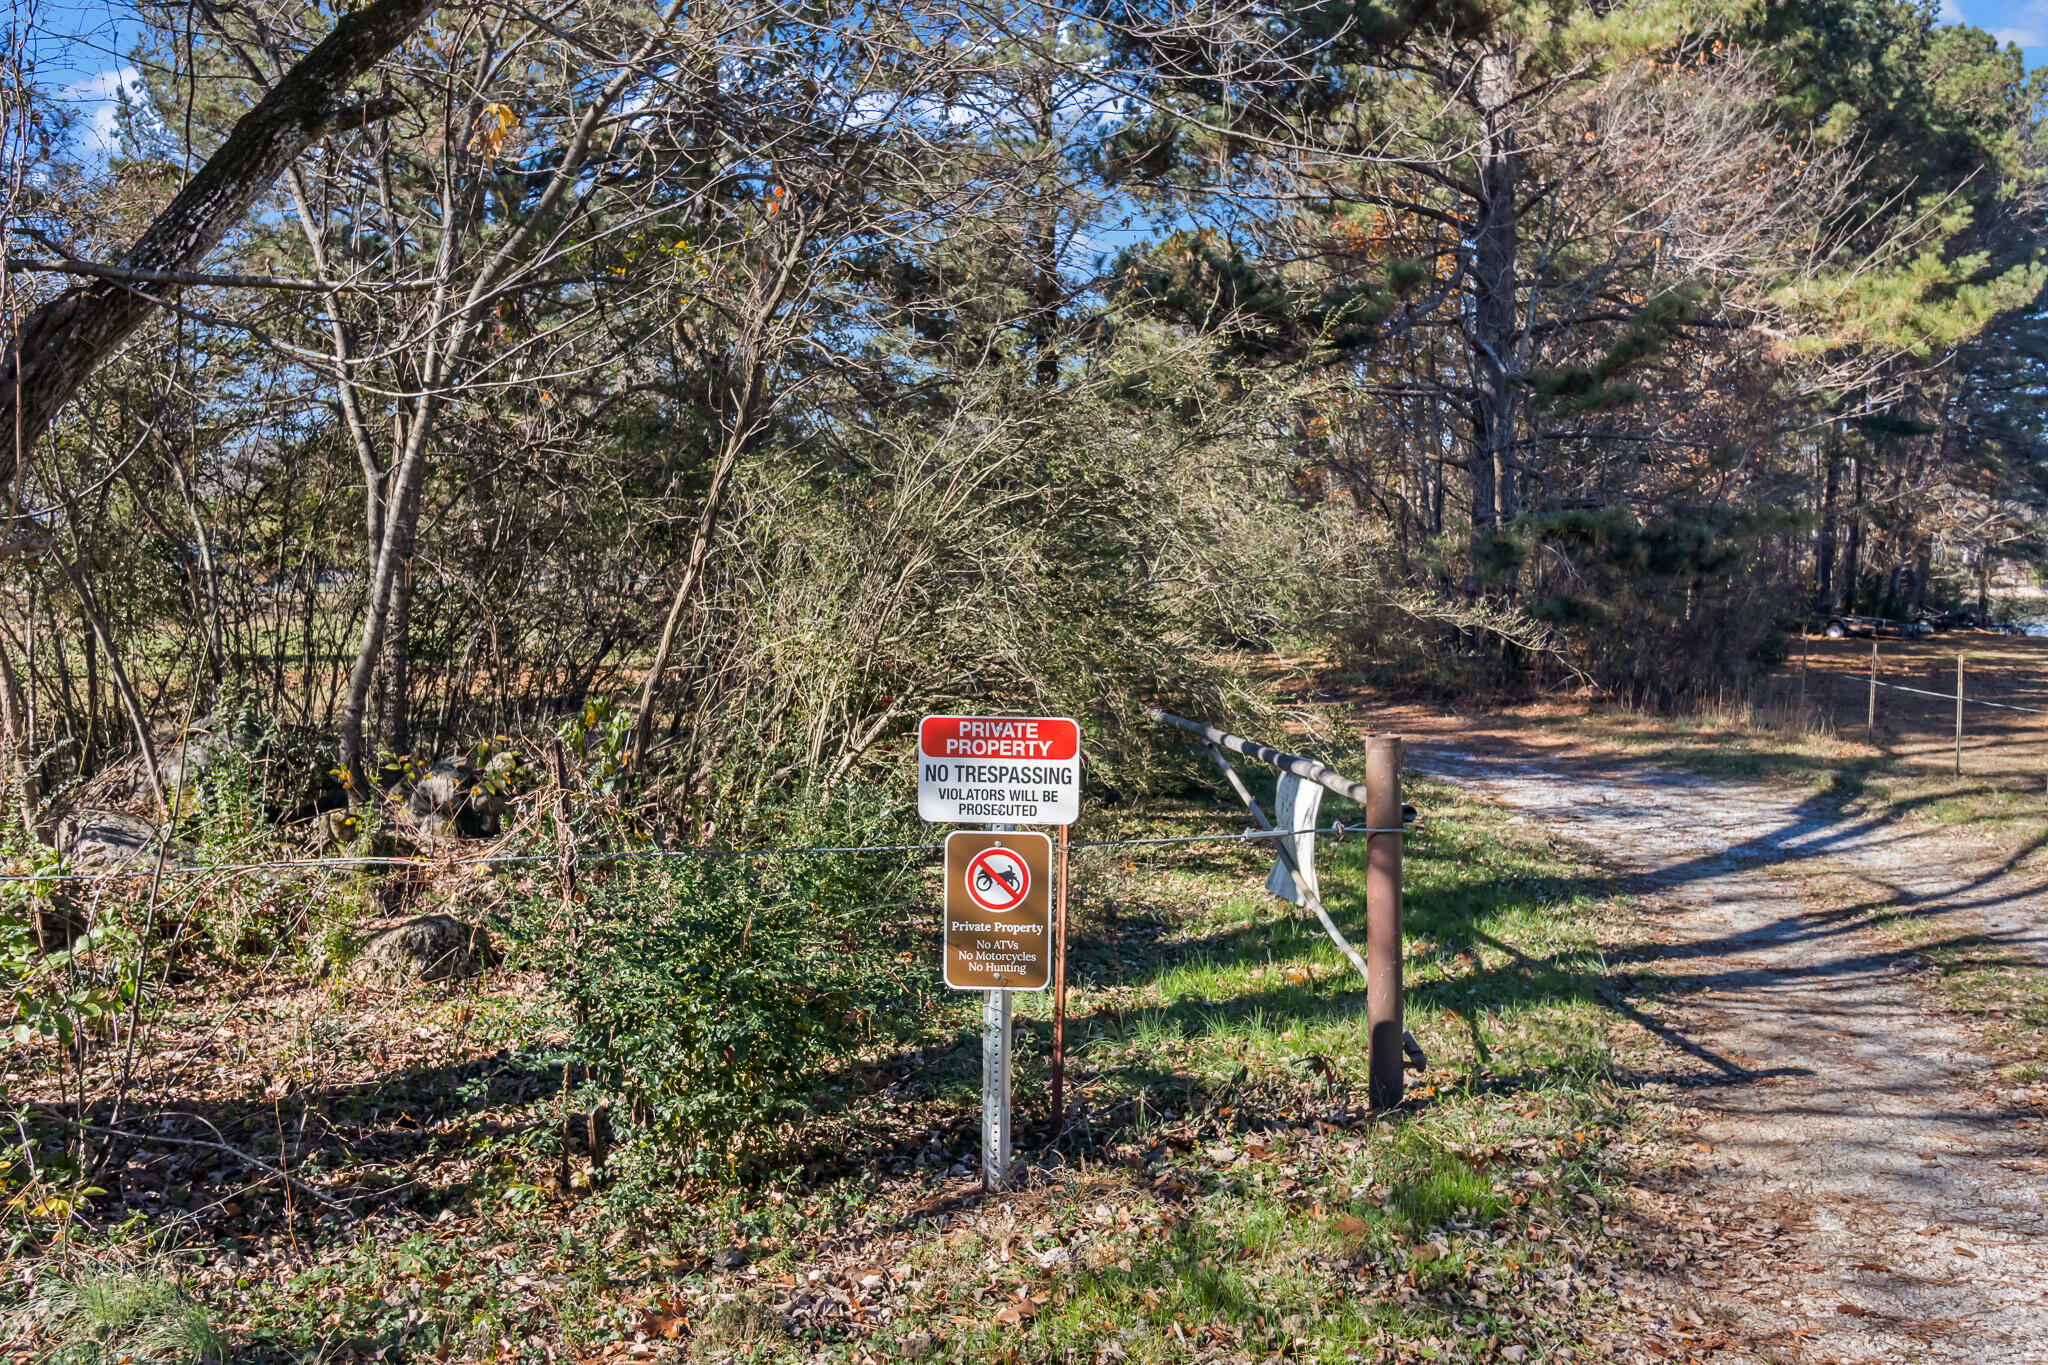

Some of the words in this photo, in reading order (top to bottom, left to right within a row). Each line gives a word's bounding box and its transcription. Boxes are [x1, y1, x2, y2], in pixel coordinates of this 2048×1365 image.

[959, 721, 1039, 739] PRIVATE
[946, 739, 1053, 757] PROPERTY
[925, 764, 948, 782] NO
[955, 765, 1072, 785] TRESPASSING
[938, 788, 1005, 801] VIOLATORS
[1009, 790, 1039, 802] WILL
[1043, 790, 1058, 803] BE
[958, 804, 1038, 817] PROSECUTED
[952, 921, 991, 932] Private
[994, 922, 1044, 935] Property
[976, 940, 991, 949] No
[993, 940, 1019, 950] ATVs
[958, 951, 973, 961] No
[976, 952, 1037, 965] Motorcycles
[968, 962, 983, 972] No
[986, 962, 1027, 975] Hunting
